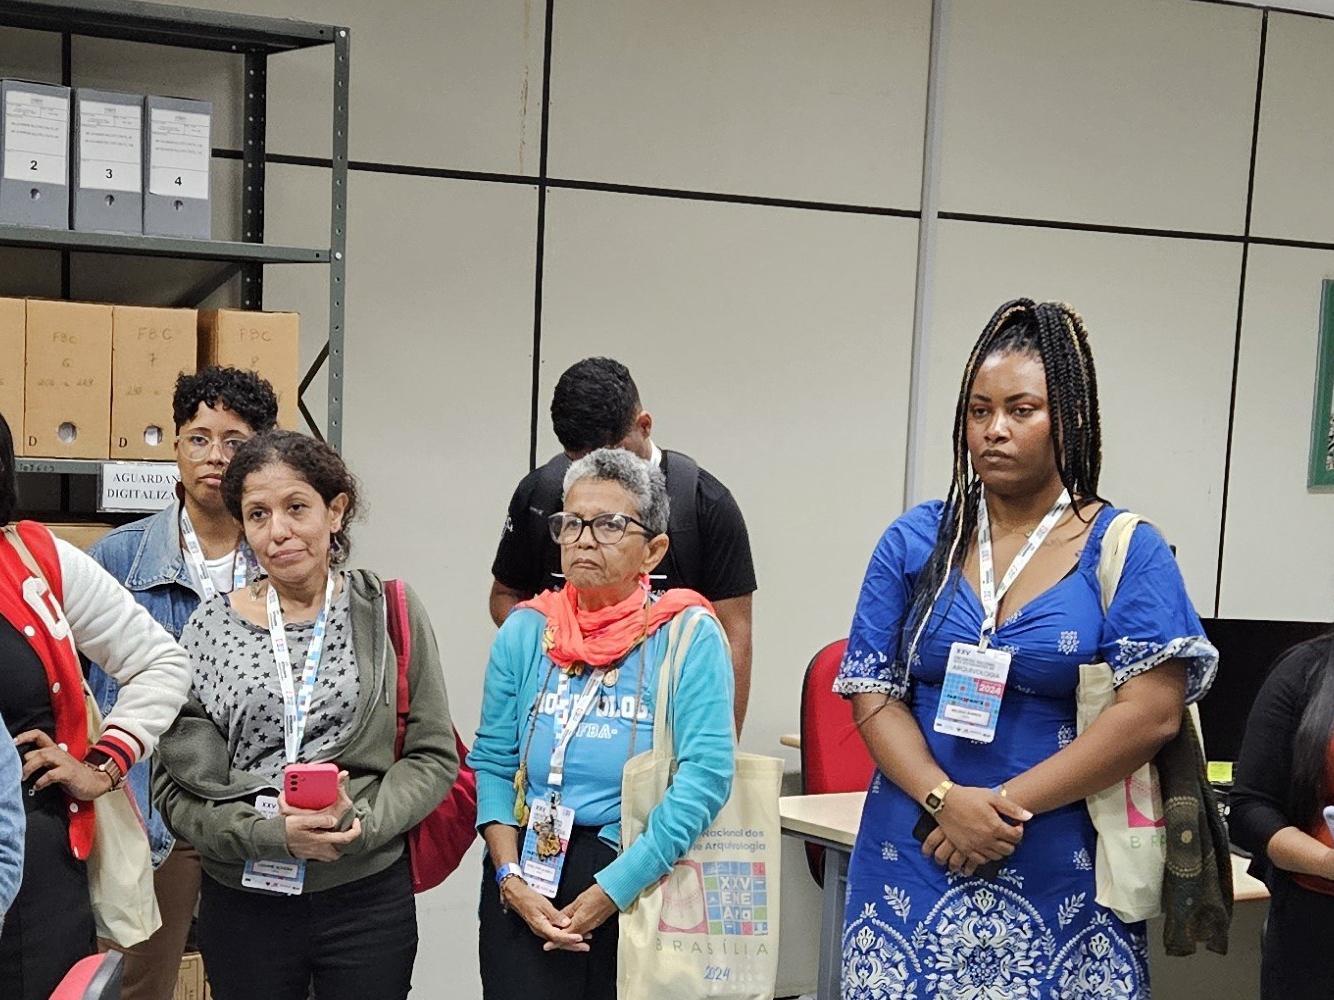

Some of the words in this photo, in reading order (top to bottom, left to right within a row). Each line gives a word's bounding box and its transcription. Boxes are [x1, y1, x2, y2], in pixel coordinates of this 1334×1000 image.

[30, 160, 38, 171] 2
[105, 168, 113, 179] 3
[174, 176, 182, 186] 4
[28, 435, 37, 447] D
[119, 437, 127, 448] D
[978, 685, 1002, 695] 2024
[745, 829, 764, 838] dos
[719, 876, 751, 890] XXV
[722, 891, 752, 905] ENE
[655, 938, 768, 956] BRASÍLIA
